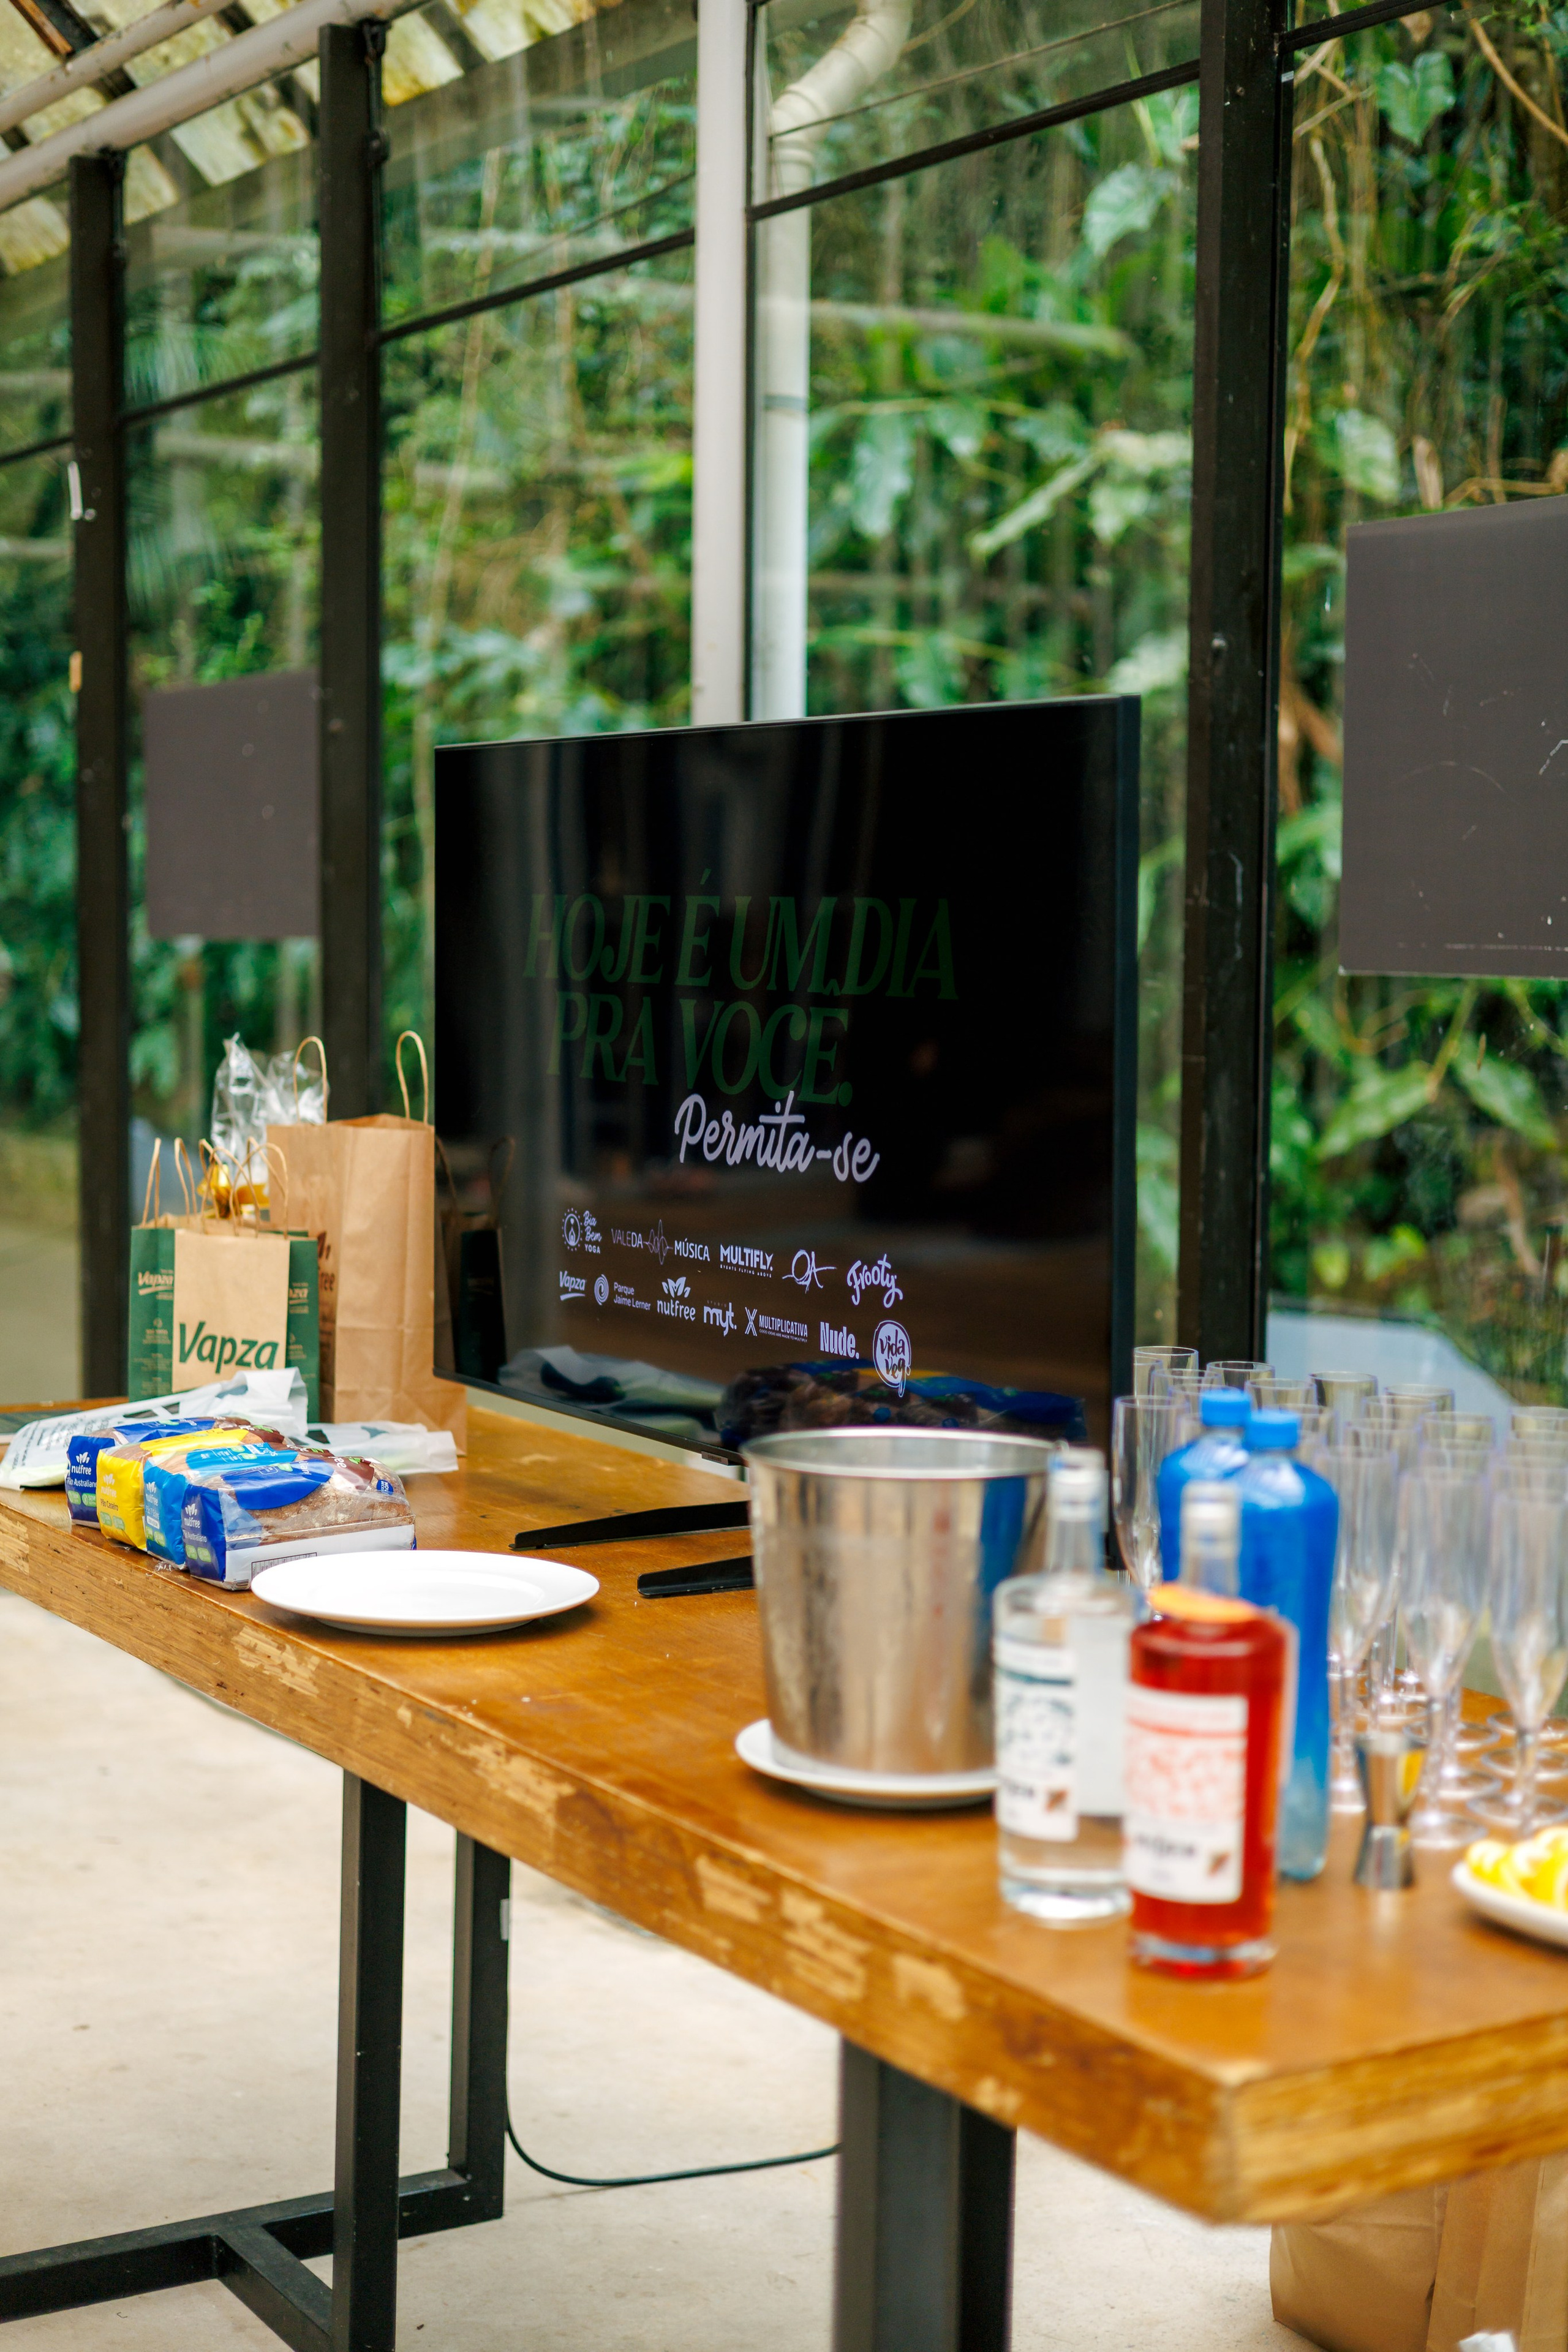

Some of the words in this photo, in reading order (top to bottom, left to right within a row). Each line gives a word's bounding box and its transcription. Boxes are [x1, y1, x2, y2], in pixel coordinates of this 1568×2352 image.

[522, 893, 671, 984] HOJE
[674, 867, 720, 987] É
[729, 895, 839, 993] UM
[841, 896, 959, 1000] DIA
[546, 990, 659, 1085] PRA
[674, 1090, 880, 1183] Permita-se
[583, 1210, 597, 1226] Bia
[584, 1226, 602, 1242] Bem
[584, 1243, 601, 1254] YOGA
[674, 1238, 710, 1262] MÚSICA
[137, 1270, 174, 1287] Vapza
[559, 1270, 586, 1292] Vapza
[846, 1253, 903, 1308] Frooty
[614, 1282, 635, 1296] Parque
[614, 1294, 631, 1307] Jaime
[632, 1298, 651, 1311] Lerner
[657, 1299, 696, 1322] nutfree
[759, 1314, 808, 1338] MULTIPLICATIVA
[179, 1321, 279, 1374] Vapza
[71, 1464, 92, 1475] nutfree
[100, 1486, 117, 1498] nutfree
[184, 1517, 201, 1529] nutfree
